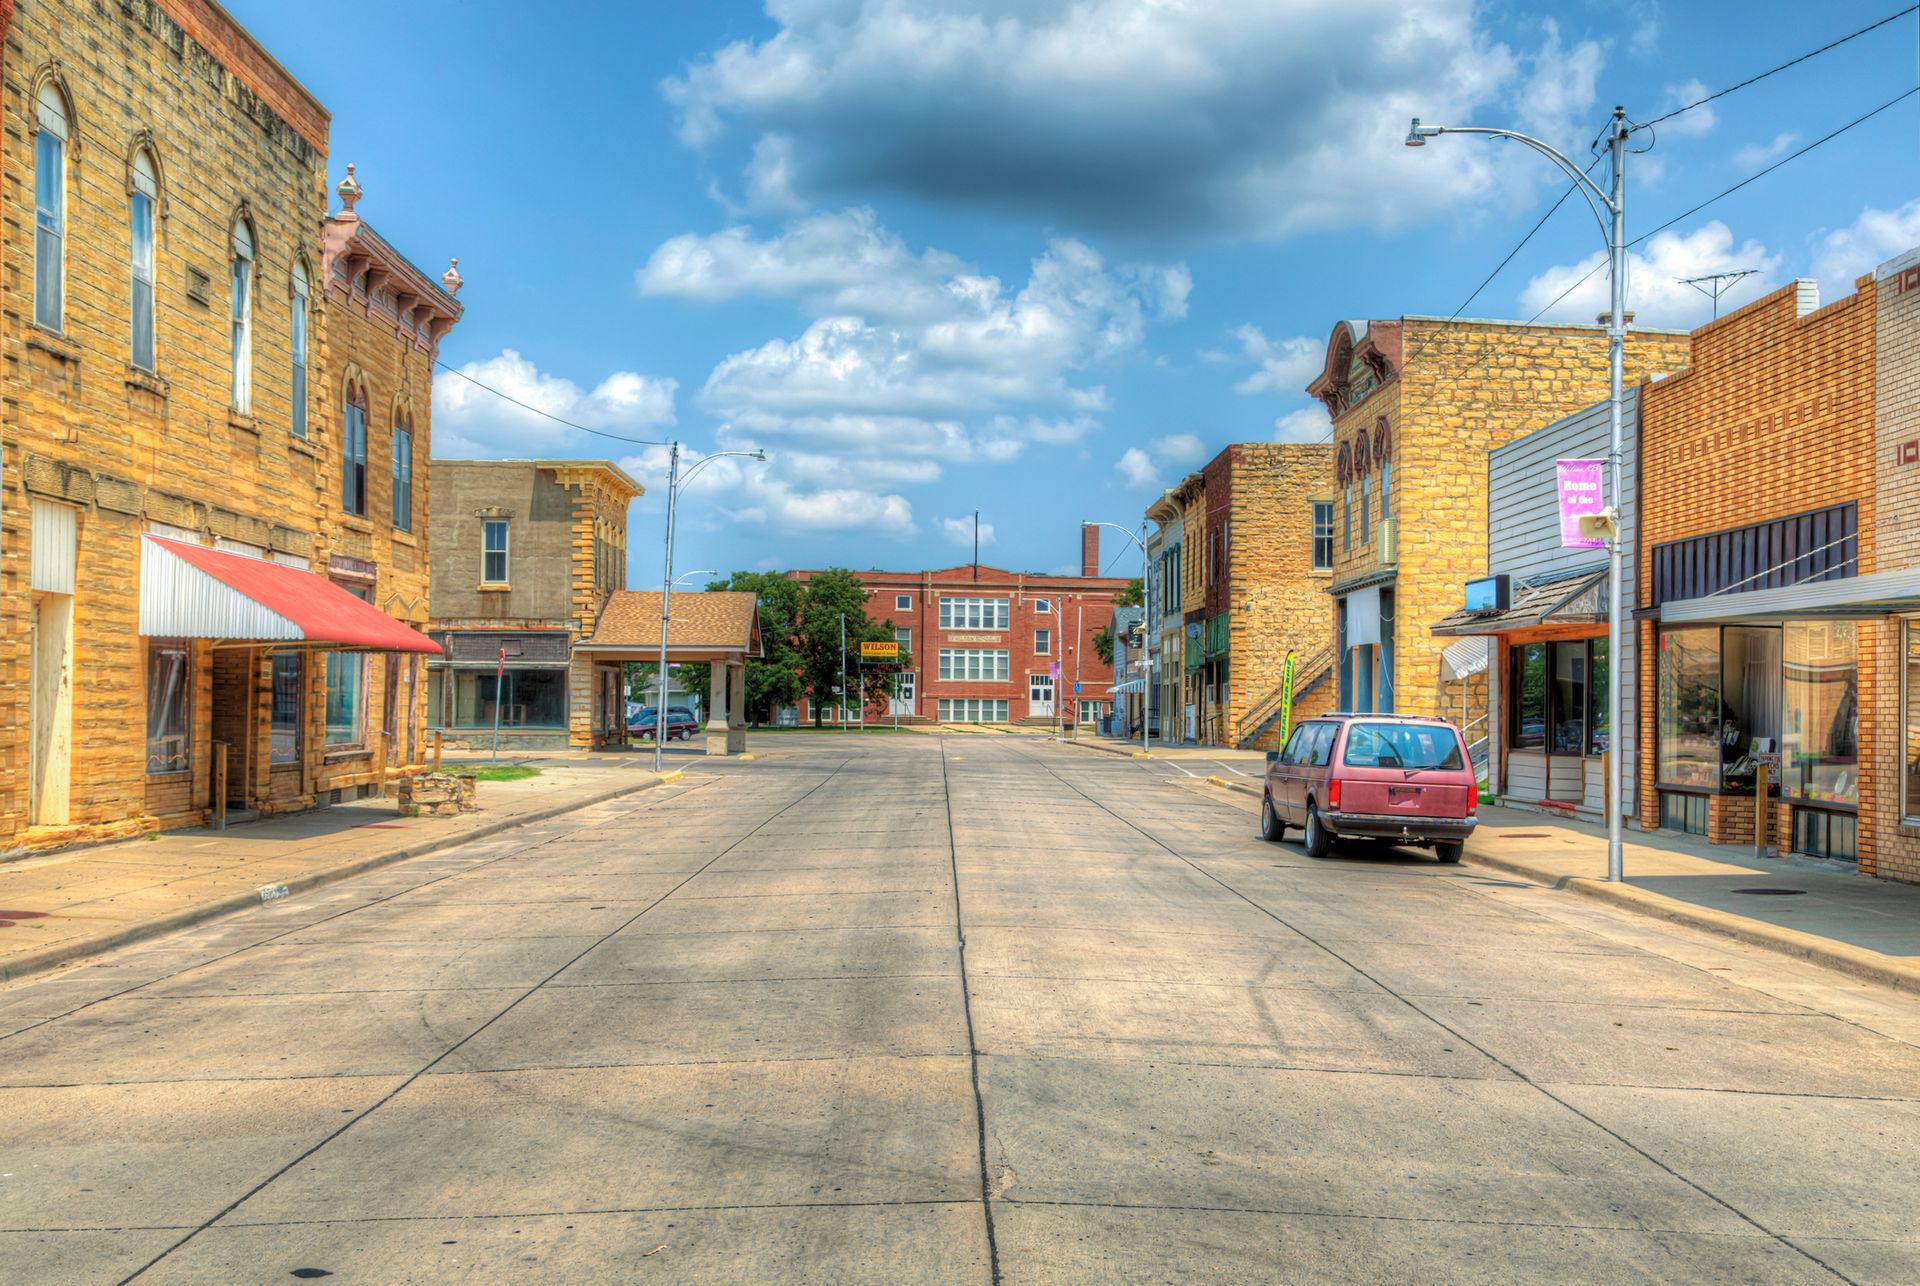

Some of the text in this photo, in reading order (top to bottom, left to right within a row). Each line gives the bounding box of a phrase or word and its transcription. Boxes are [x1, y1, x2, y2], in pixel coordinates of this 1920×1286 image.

[1563, 480, 1597, 491] Home
[1567, 495, 1594, 504] of the
